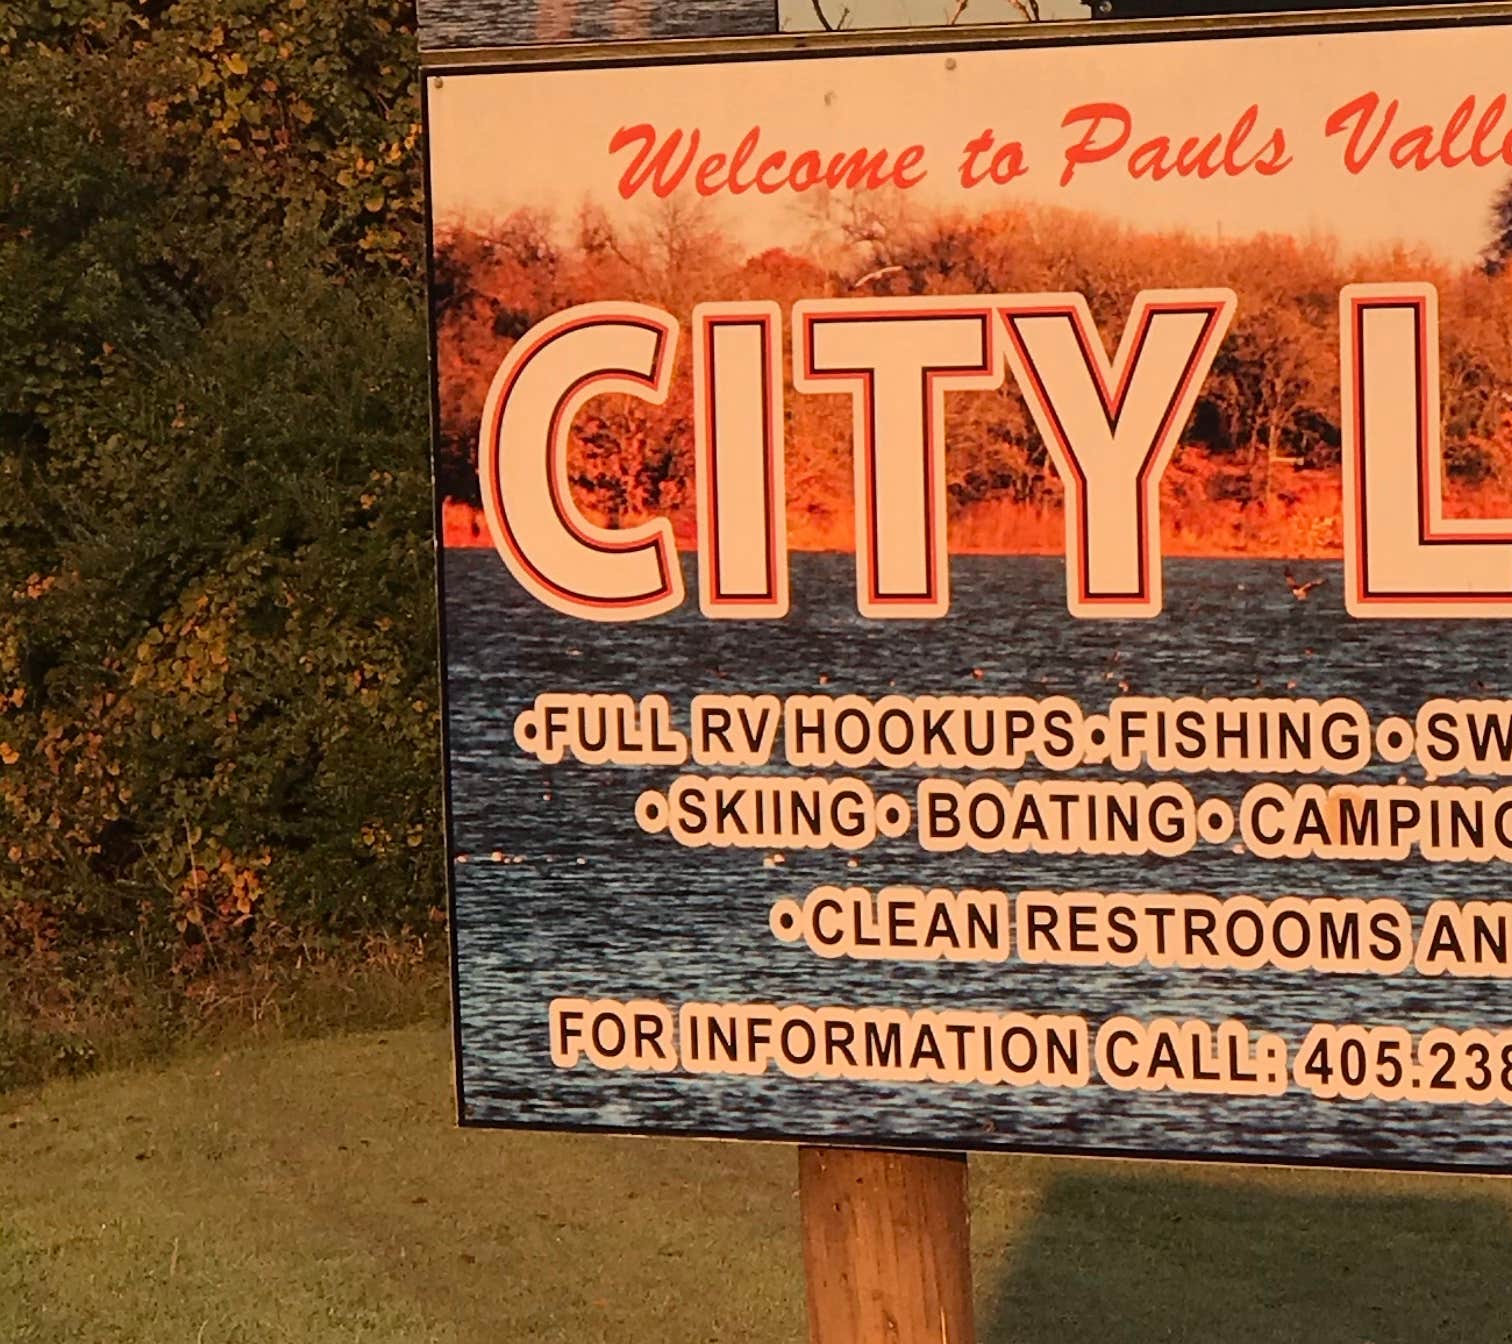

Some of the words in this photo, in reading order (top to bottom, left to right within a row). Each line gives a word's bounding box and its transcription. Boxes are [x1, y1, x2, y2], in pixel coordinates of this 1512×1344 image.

[611, 124, 924, 199] Welcome
[959, 128, 1030, 188] to
[1060, 102, 1293, 186] Pauls
[486, 298, 1228, 612] CITY
[545, 707, 676, 751] FULL
[702, 708, 769, 752] RV
[796, 709, 1073, 756] HOOKUPS
[1121, 711, 1358, 760] FISHING
[679, 789, 864, 836] SKIING
[928, 792, 1185, 843] BOATING
[813, 900, 998, 948] CLEAN
[1028, 905, 1401, 960] RESTROOMS
[560, 1012, 665, 1058] FOR
[691, 1016, 1077, 1074] INFORMATION
[1107, 1031, 1275, 1082] CALL:
